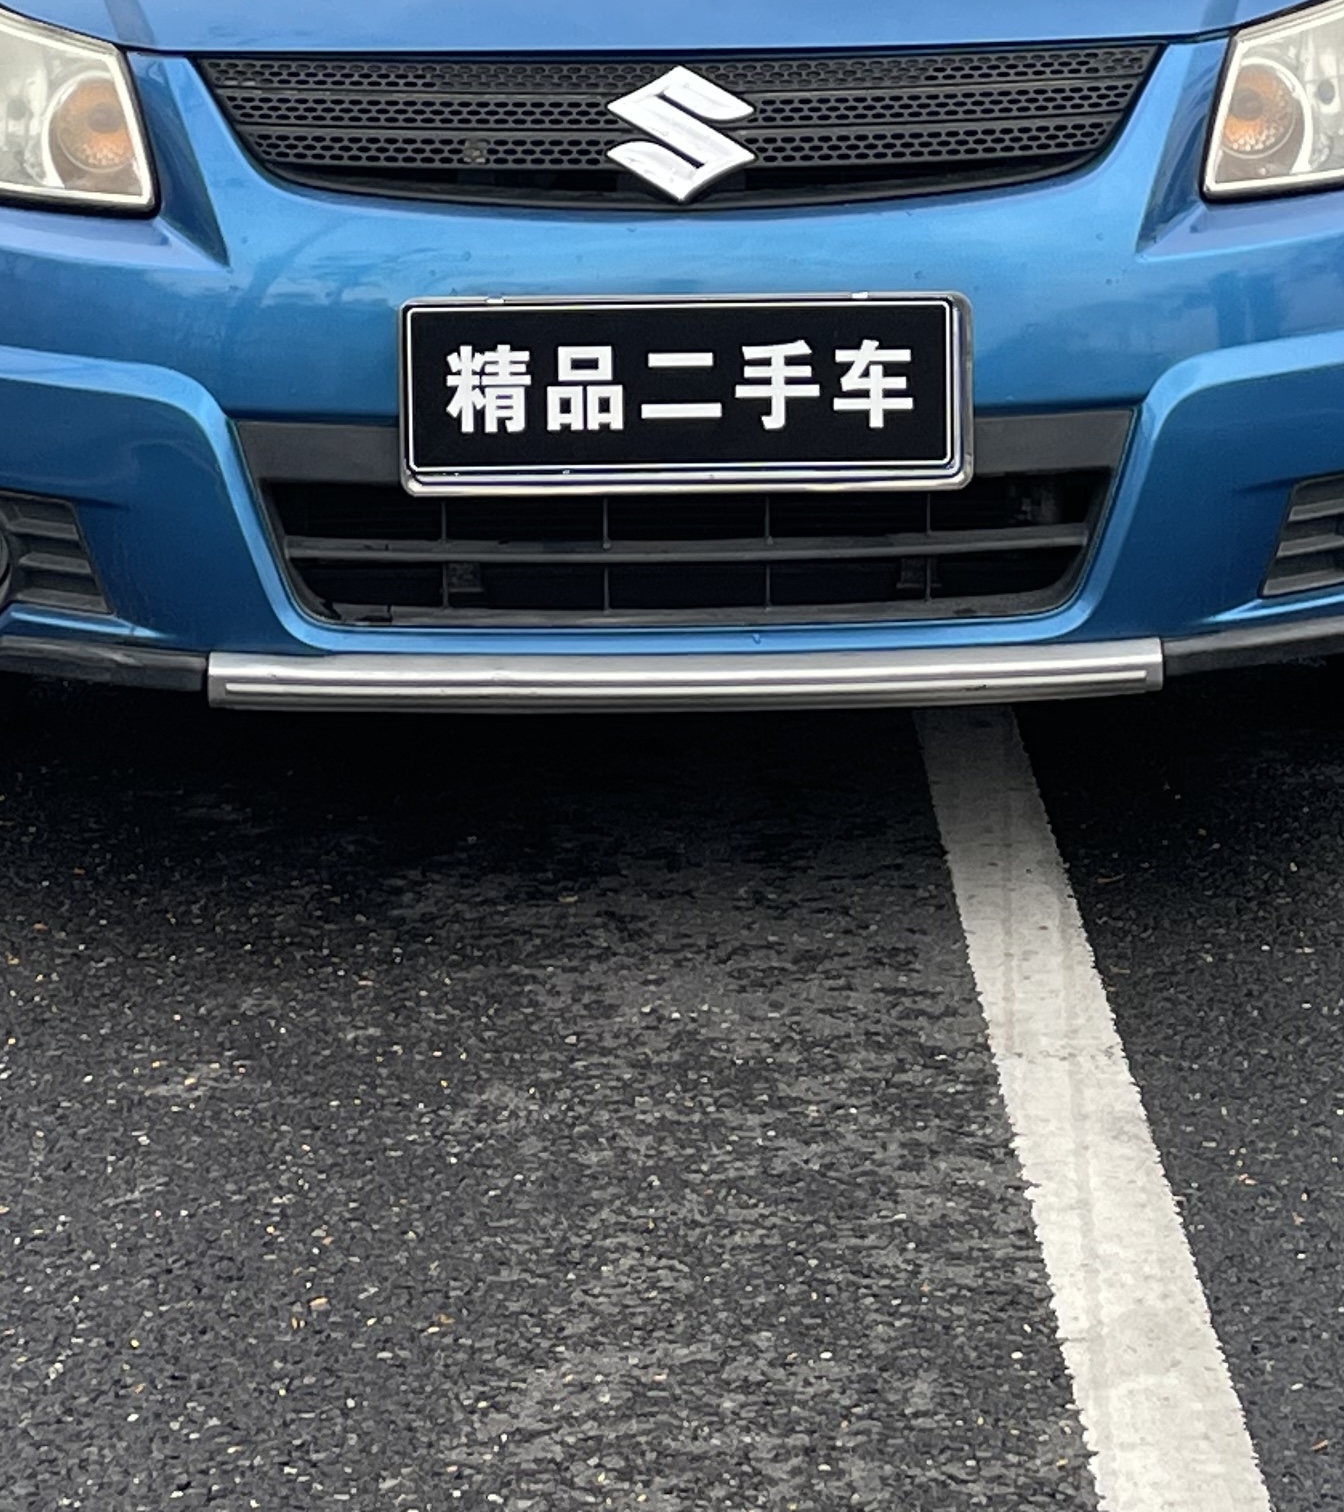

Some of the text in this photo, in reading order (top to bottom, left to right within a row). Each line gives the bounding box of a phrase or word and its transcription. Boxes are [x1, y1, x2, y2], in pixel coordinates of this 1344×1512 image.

[445, 339, 915, 434] 精品二手车
